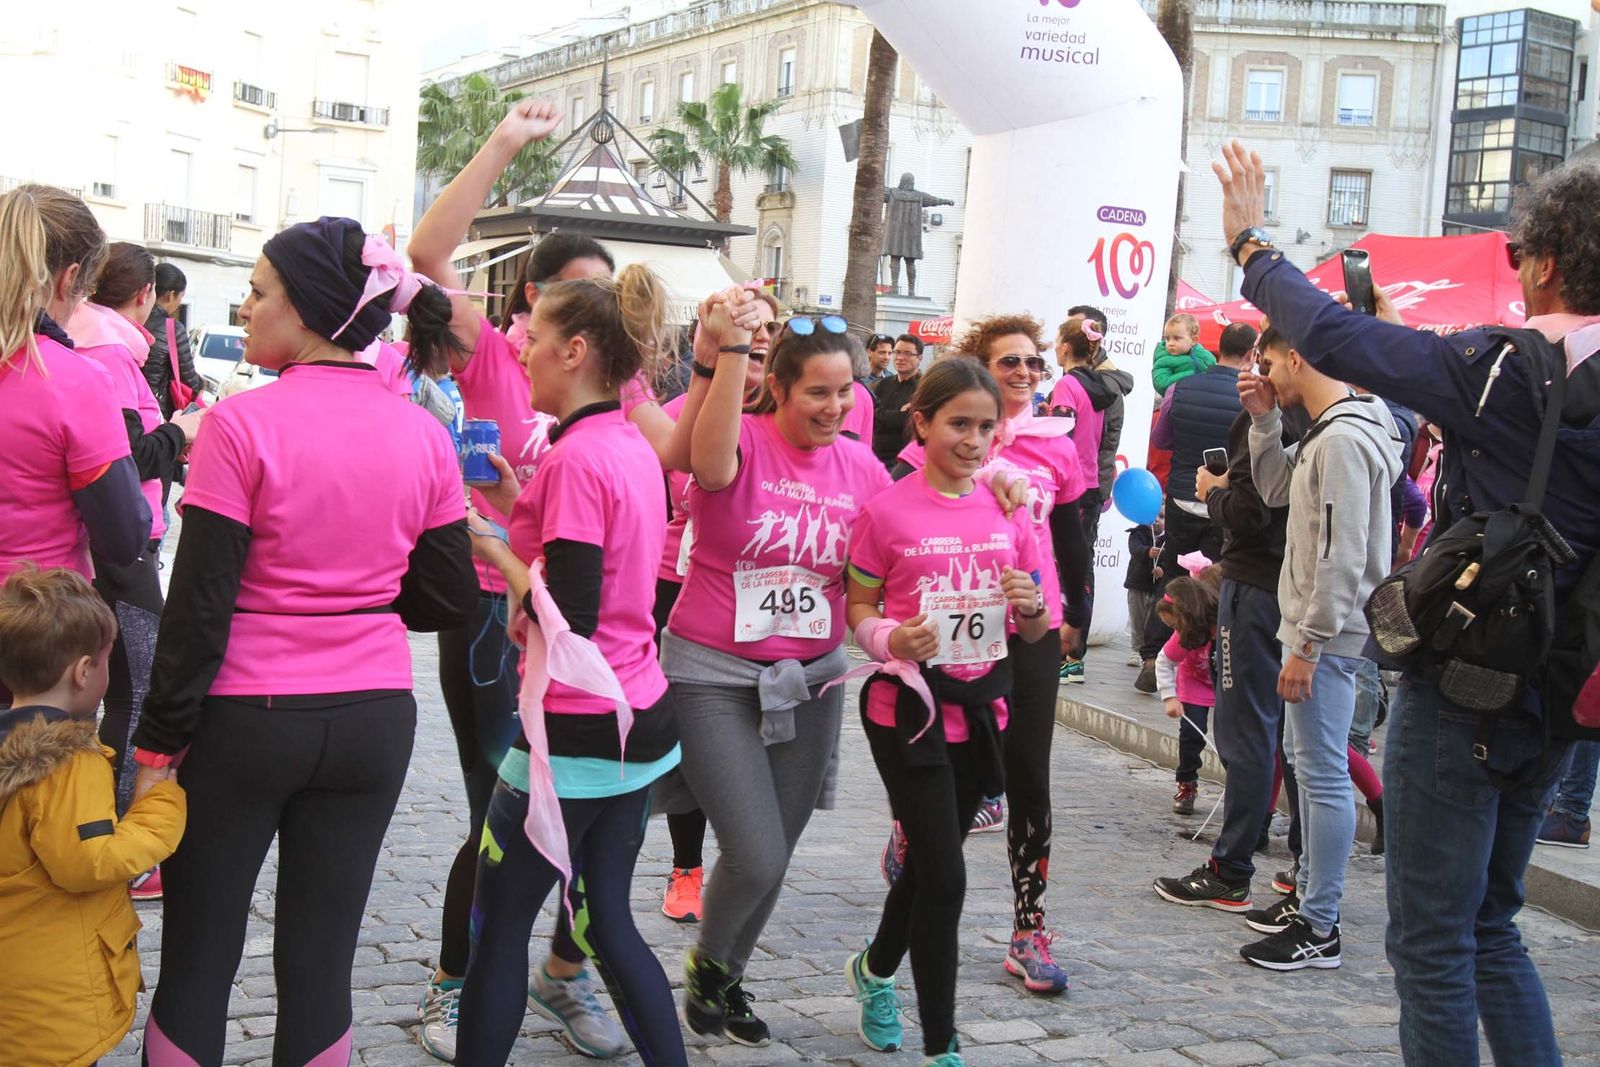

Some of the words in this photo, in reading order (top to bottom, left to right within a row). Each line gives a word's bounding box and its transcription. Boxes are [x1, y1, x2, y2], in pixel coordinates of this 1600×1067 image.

[1026, 13, 1039, 23] La
[1042, 15, 1070, 27] mejor
[1025, 30, 1086, 44] variedad
[1020, 46, 1099, 65] musical
[1100, 208, 1144, 224] CADENA
[1103, 306, 1127, 317] mejor
[1107, 320, 1138, 335] iedad
[1103, 337, 1145, 356] usical
[761, 481, 773, 492] DE
[774, 486, 785, 497] LA
[920, 536, 963, 547] CARRERA
[904, 547, 918, 557] DE
[919, 546, 932, 556] LA
[933, 544, 964, 555] MUJER
[1094, 549, 1119, 568] ical
[759, 587, 815, 616] 495
[948, 612, 984, 641] 76
[1221, 625, 1233, 691] Joma
